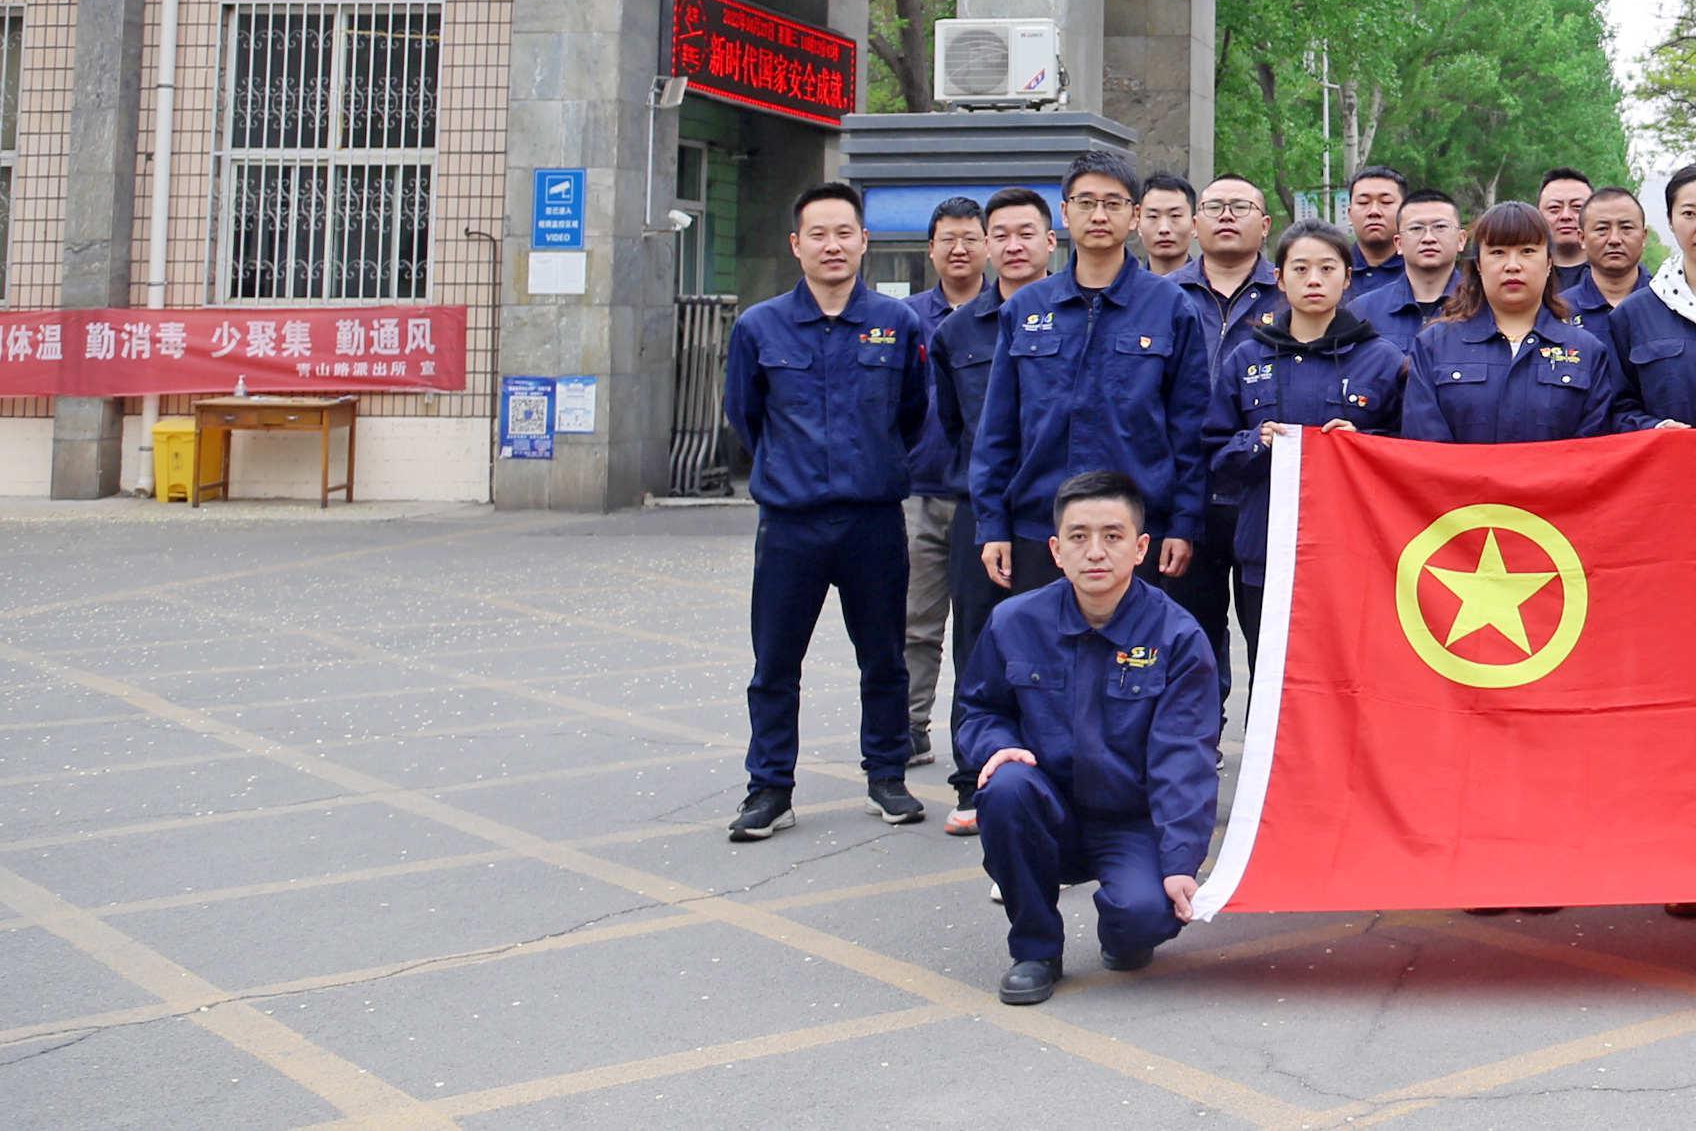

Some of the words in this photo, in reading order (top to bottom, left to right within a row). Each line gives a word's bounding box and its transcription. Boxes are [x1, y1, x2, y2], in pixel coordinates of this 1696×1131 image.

[0, 323, 63, 363] 体温
[84, 321, 188, 360] 勤消毒
[210, 319, 313, 358] 少聚集
[335, 317, 436, 356] 勤通风
